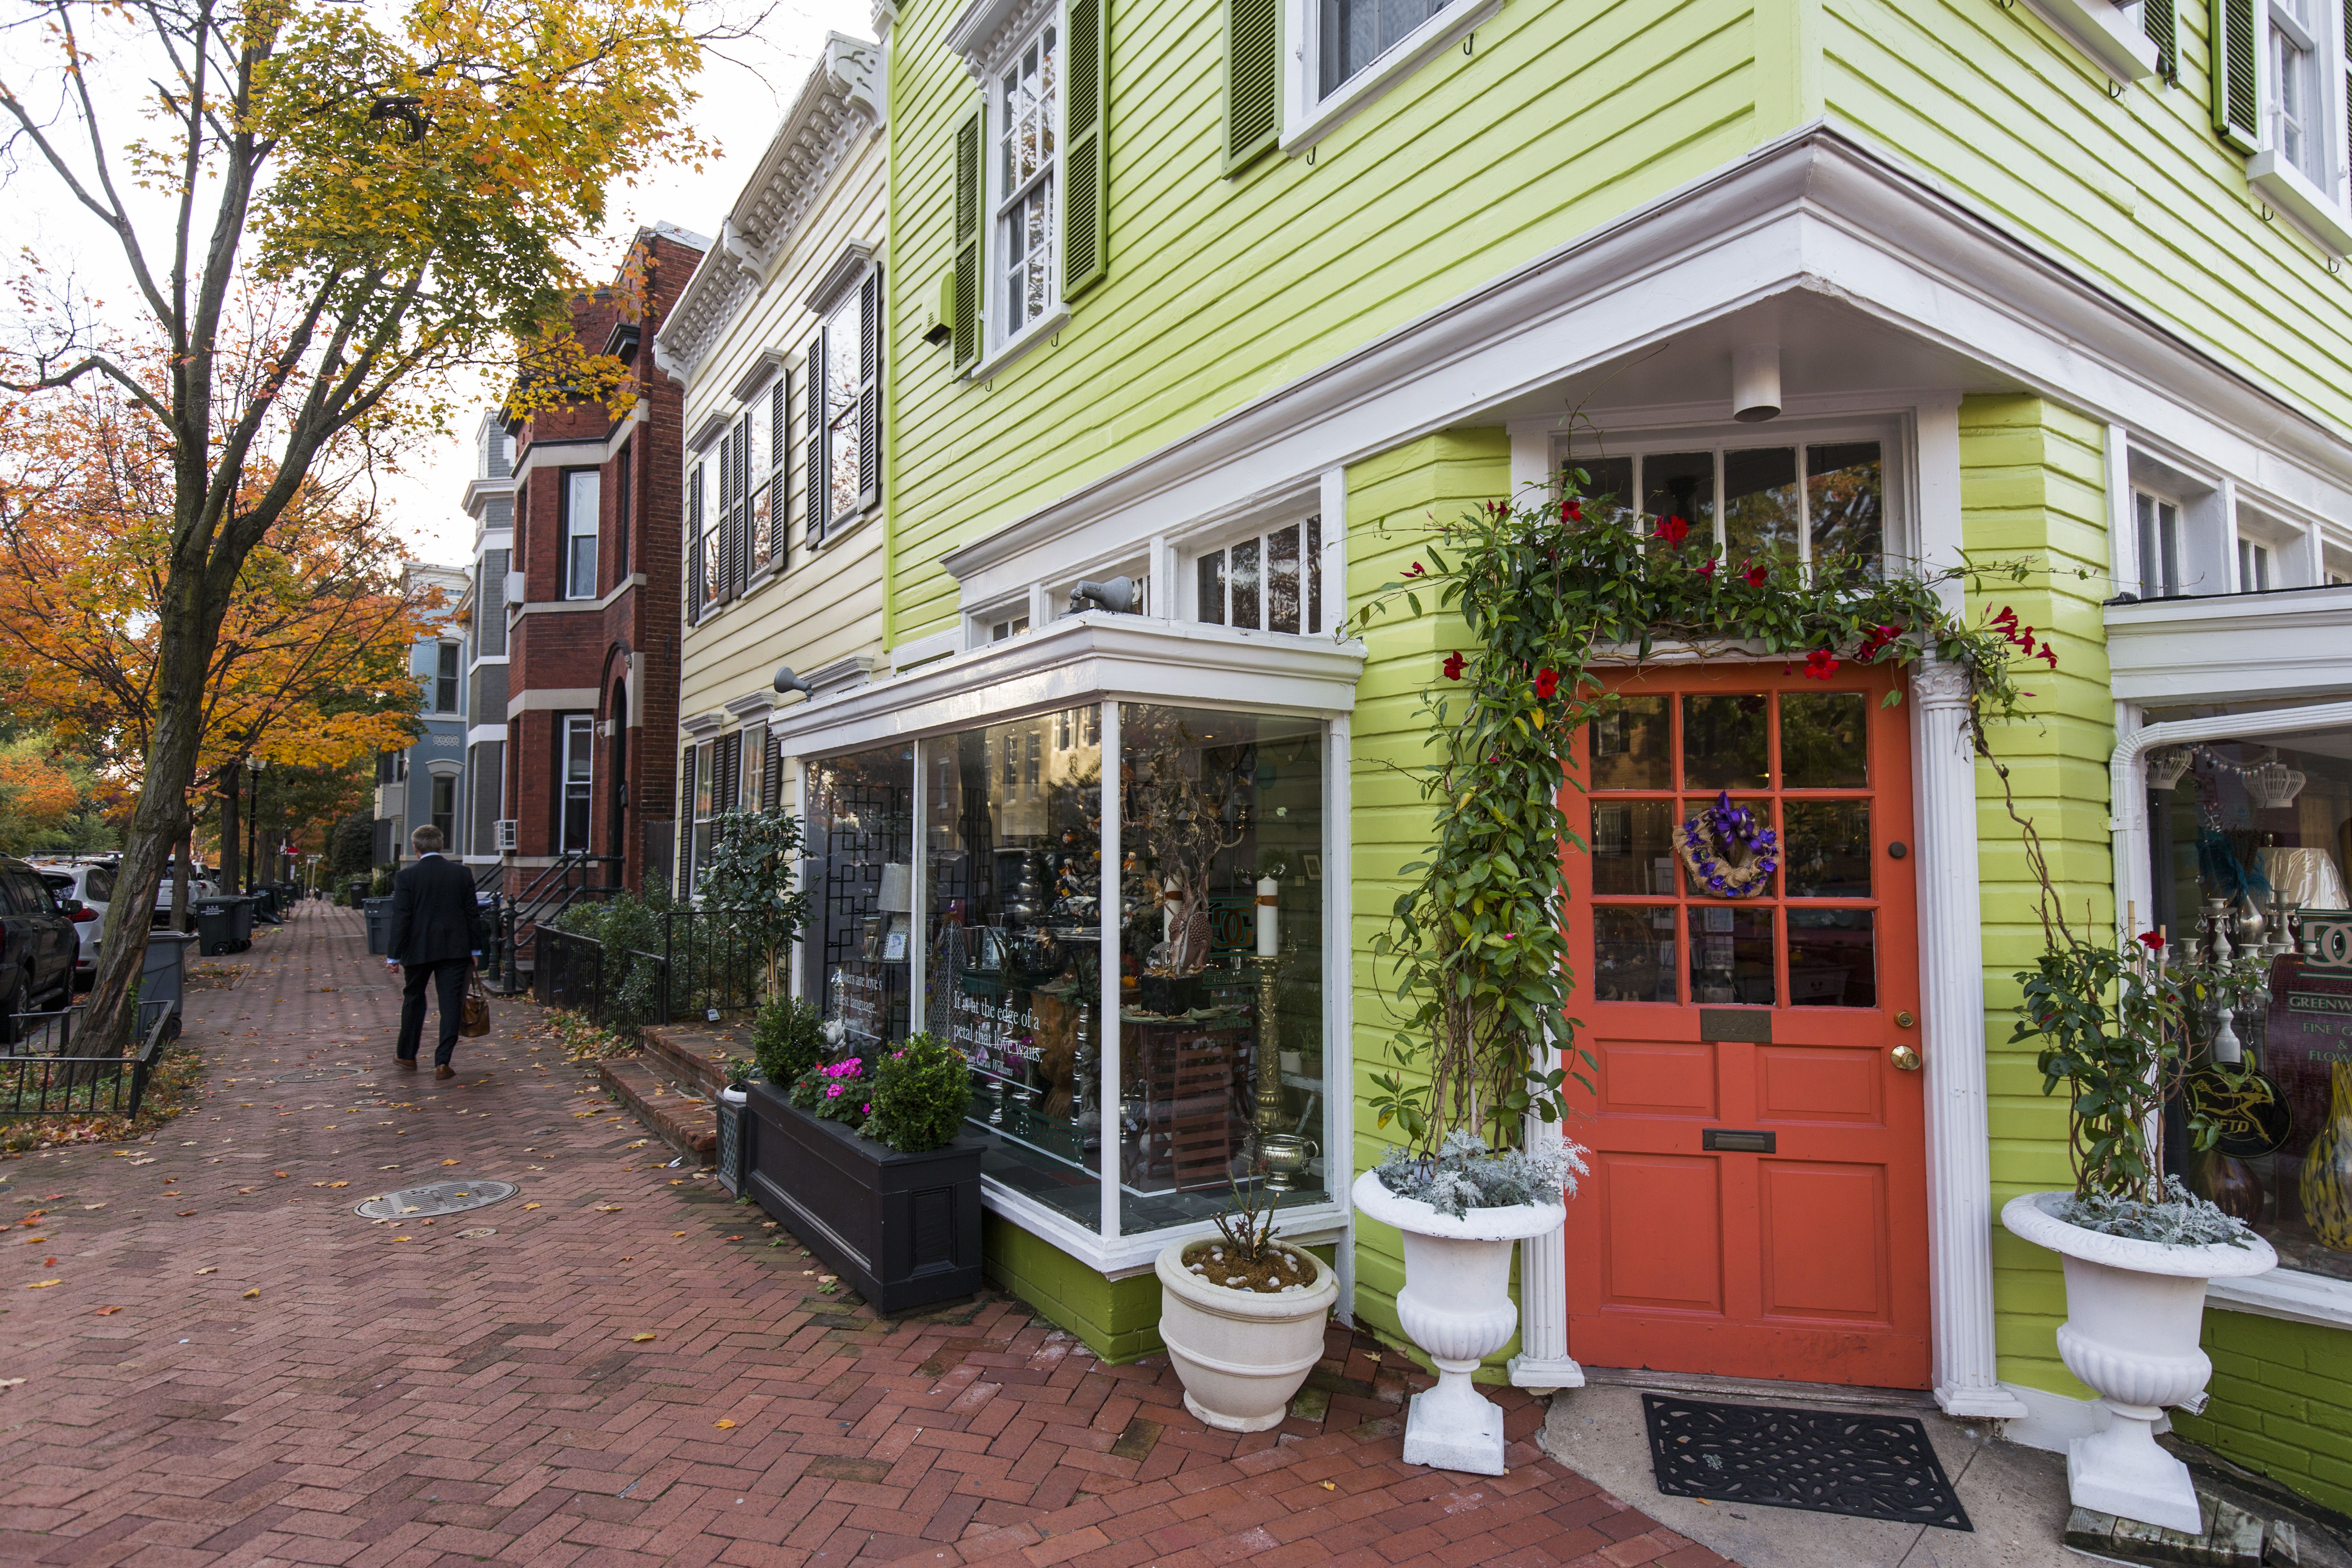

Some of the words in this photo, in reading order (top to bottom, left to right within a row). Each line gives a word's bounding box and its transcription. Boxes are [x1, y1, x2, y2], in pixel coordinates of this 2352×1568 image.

[835, 967, 855, 985] Fwers
[856, 975, 865, 987] are
[866, 972, 882, 991] love's
[850, 993, 877, 1018] language.
[954, 990, 961, 1009] It
[962, 992, 969, 1012] is
[971, 1000, 980, 1014] at
[981, 997, 995, 1018] the
[997, 1003, 1019, 1030] edge
[1021, 1008, 1033, 1028] of
[1034, 1016, 1040, 1031] a
[1212, 1017, 1253, 1031] FLOWERS
[1708, 1016, 1765, 1036] 3428
[2302, 1022, 2334, 1035] FINE
[953, 1023, 973, 1043] petal
[975, 1025, 992, 1048] that
[994, 1030, 1013, 1054] love
[1015, 1040, 1043, 1063] waits.
[2337, 1039, 2349, 1050] &
[977, 1054, 991, 1069] Carlos
[992, 1058, 1013, 1077] Williams
[2219, 1118, 2250, 1132] FTD
